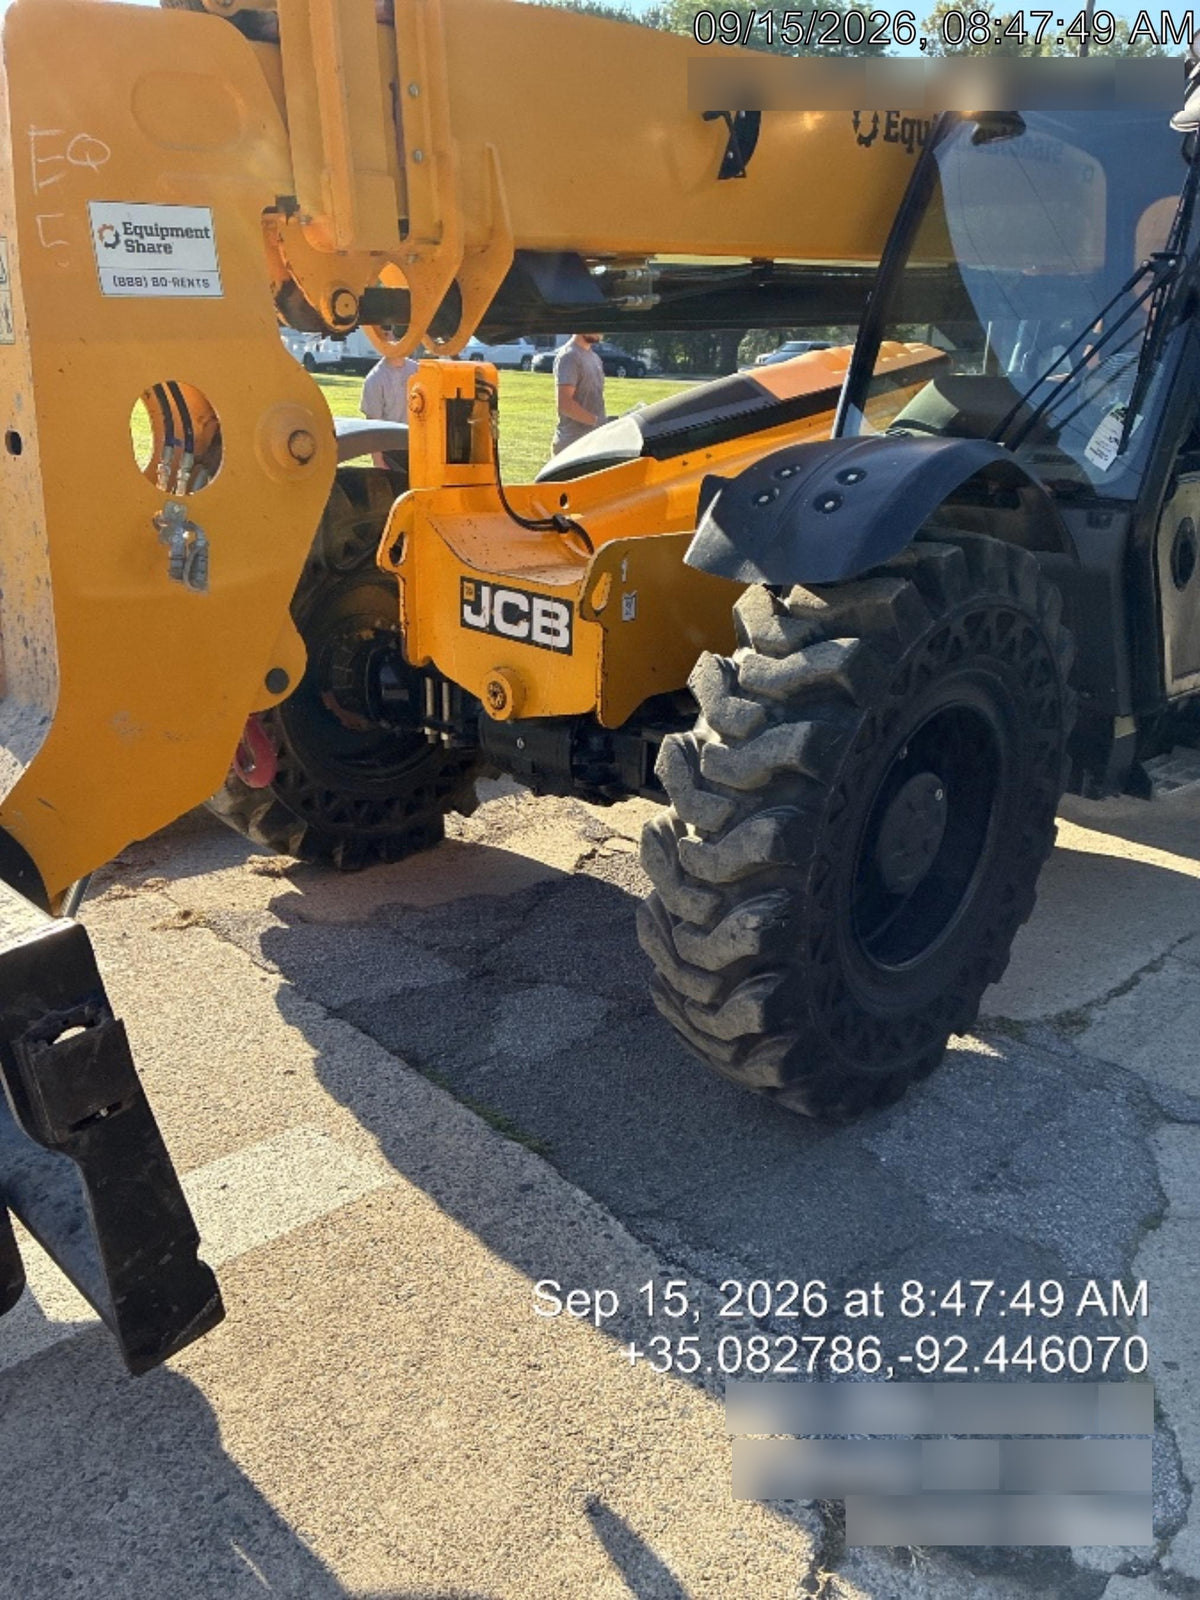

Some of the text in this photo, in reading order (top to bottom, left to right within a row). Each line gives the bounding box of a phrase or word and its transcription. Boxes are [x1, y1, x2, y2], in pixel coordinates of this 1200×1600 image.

[122, 221, 211, 241] Equipment
[124, 239, 174, 255] Share
[113, 275, 149, 288] (888)
[463, 585, 570, 648] JCB
